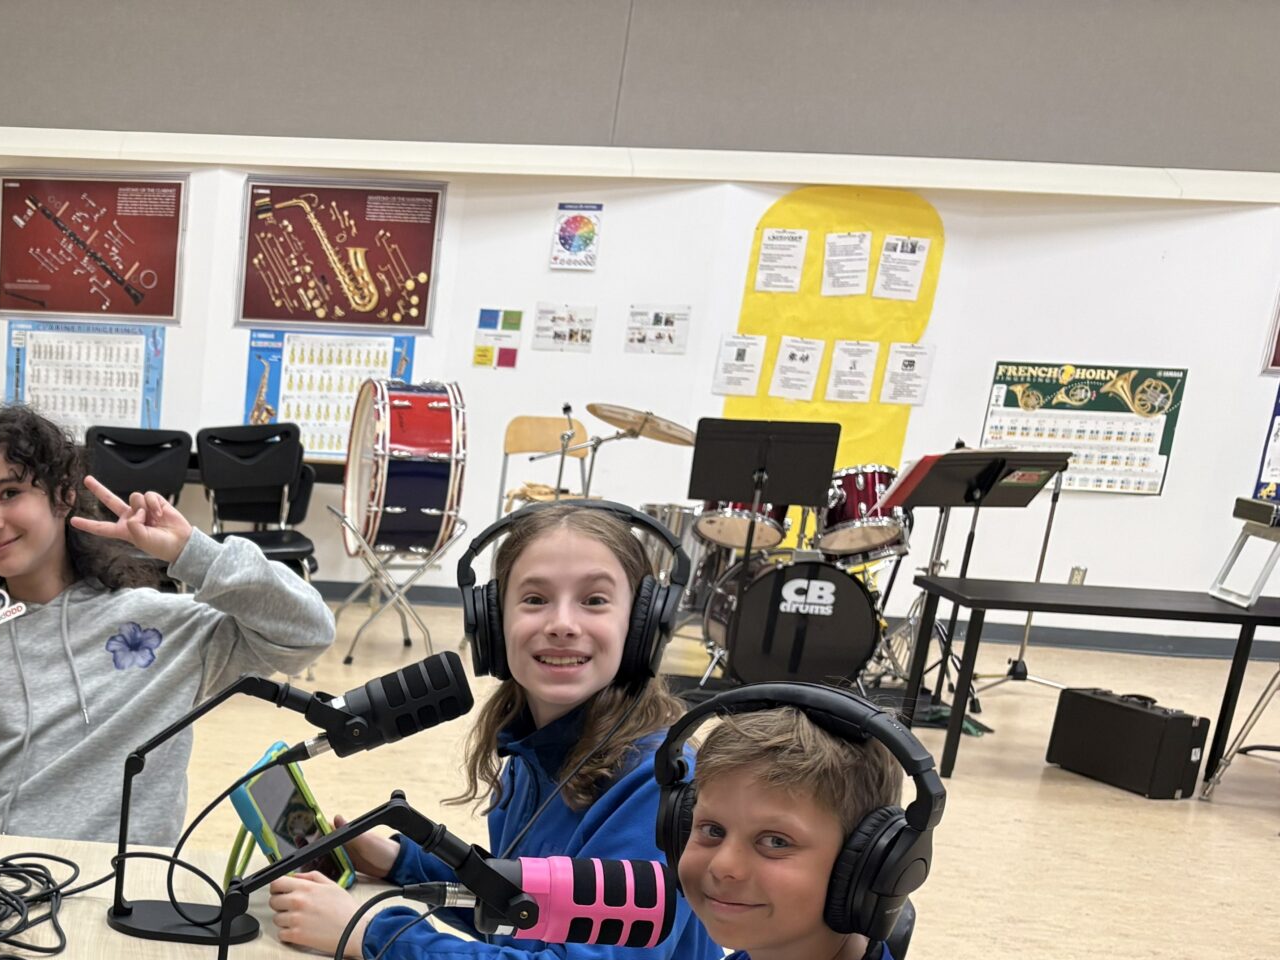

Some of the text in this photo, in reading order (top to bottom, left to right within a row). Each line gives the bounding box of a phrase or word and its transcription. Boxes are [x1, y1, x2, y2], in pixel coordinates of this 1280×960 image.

[996, 364, 1119, 380] FRENCH HORN
[781, 578, 836, 606] CB
[779, 601, 834, 616] drums
